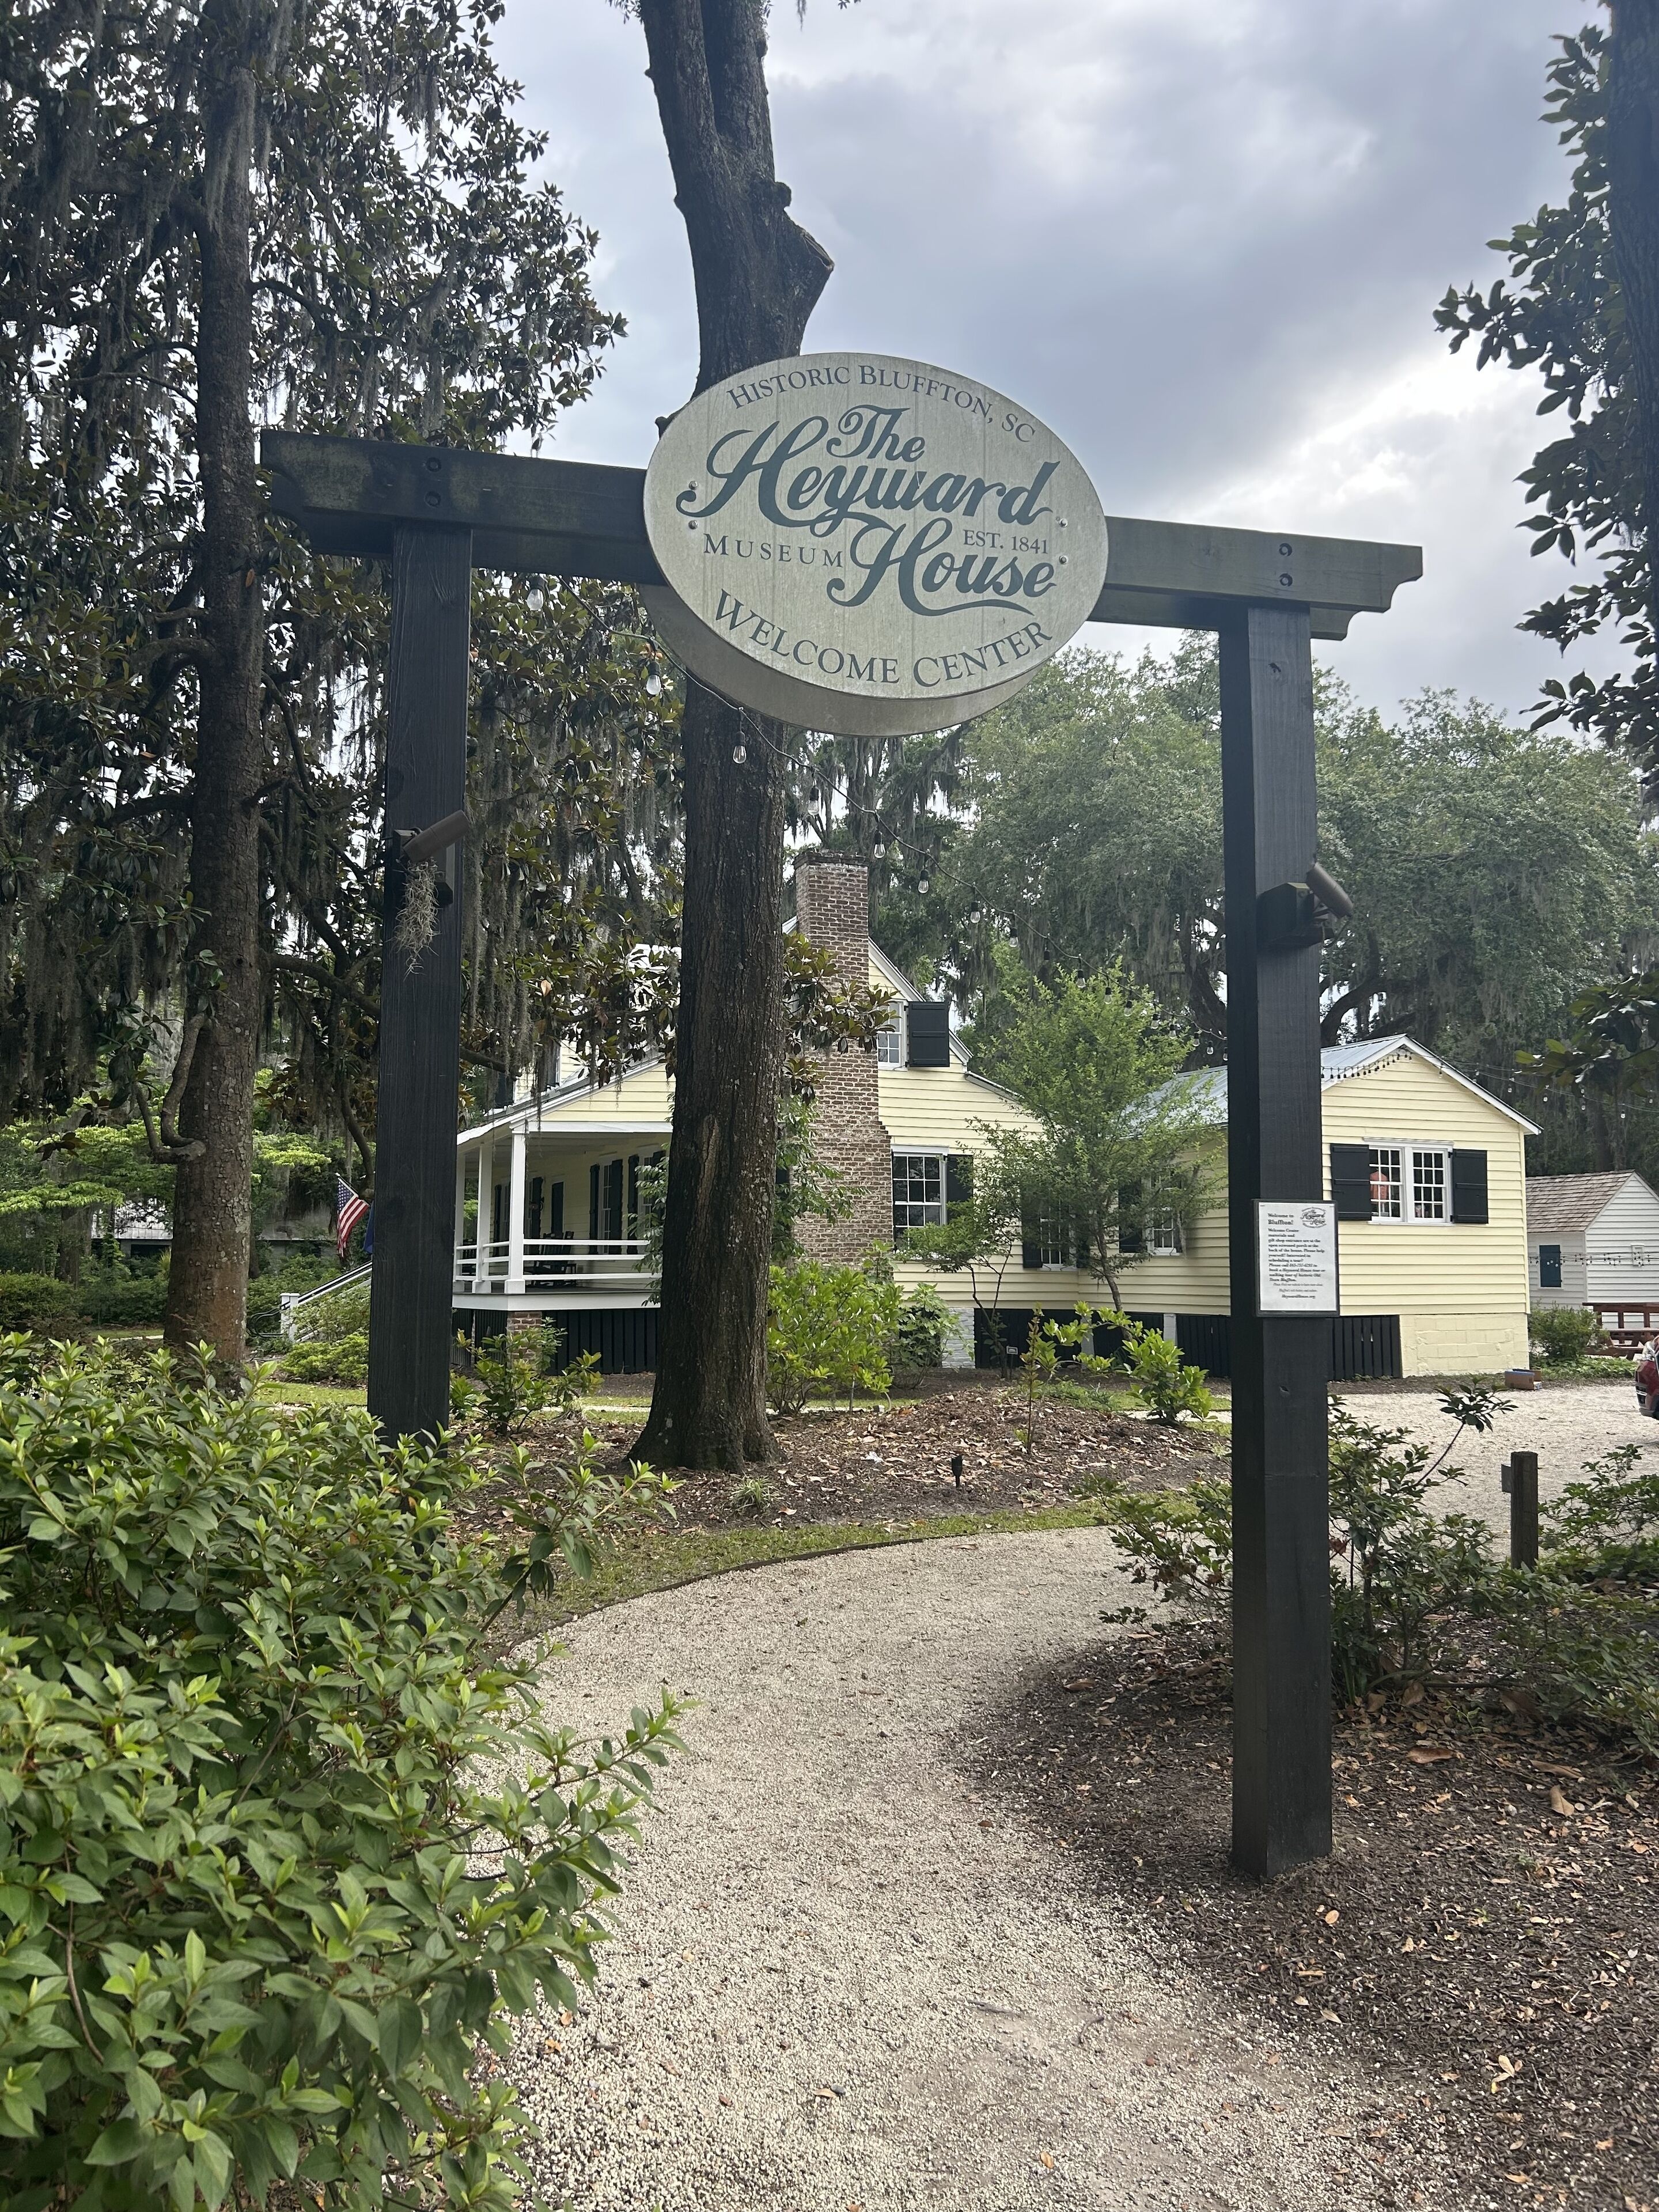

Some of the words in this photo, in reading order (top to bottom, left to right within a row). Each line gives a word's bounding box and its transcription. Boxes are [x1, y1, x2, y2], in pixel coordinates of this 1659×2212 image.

[726, 366, 851, 409] HISTORIC
[858, 365, 994, 424] BLUFFTON,
[1001, 412, 1036, 444] SC
[826, 404, 925, 462] The
[676, 416, 1060, 537] Heyward
[703, 533, 843, 568] MUSEUM
[827, 513, 1056, 616] House
[963, 530, 1004, 550] EST.
[1011, 537, 1048, 555] 1841
[714, 589, 900, 685] WELCOME
[913, 622, 1053, 687] CENTER
